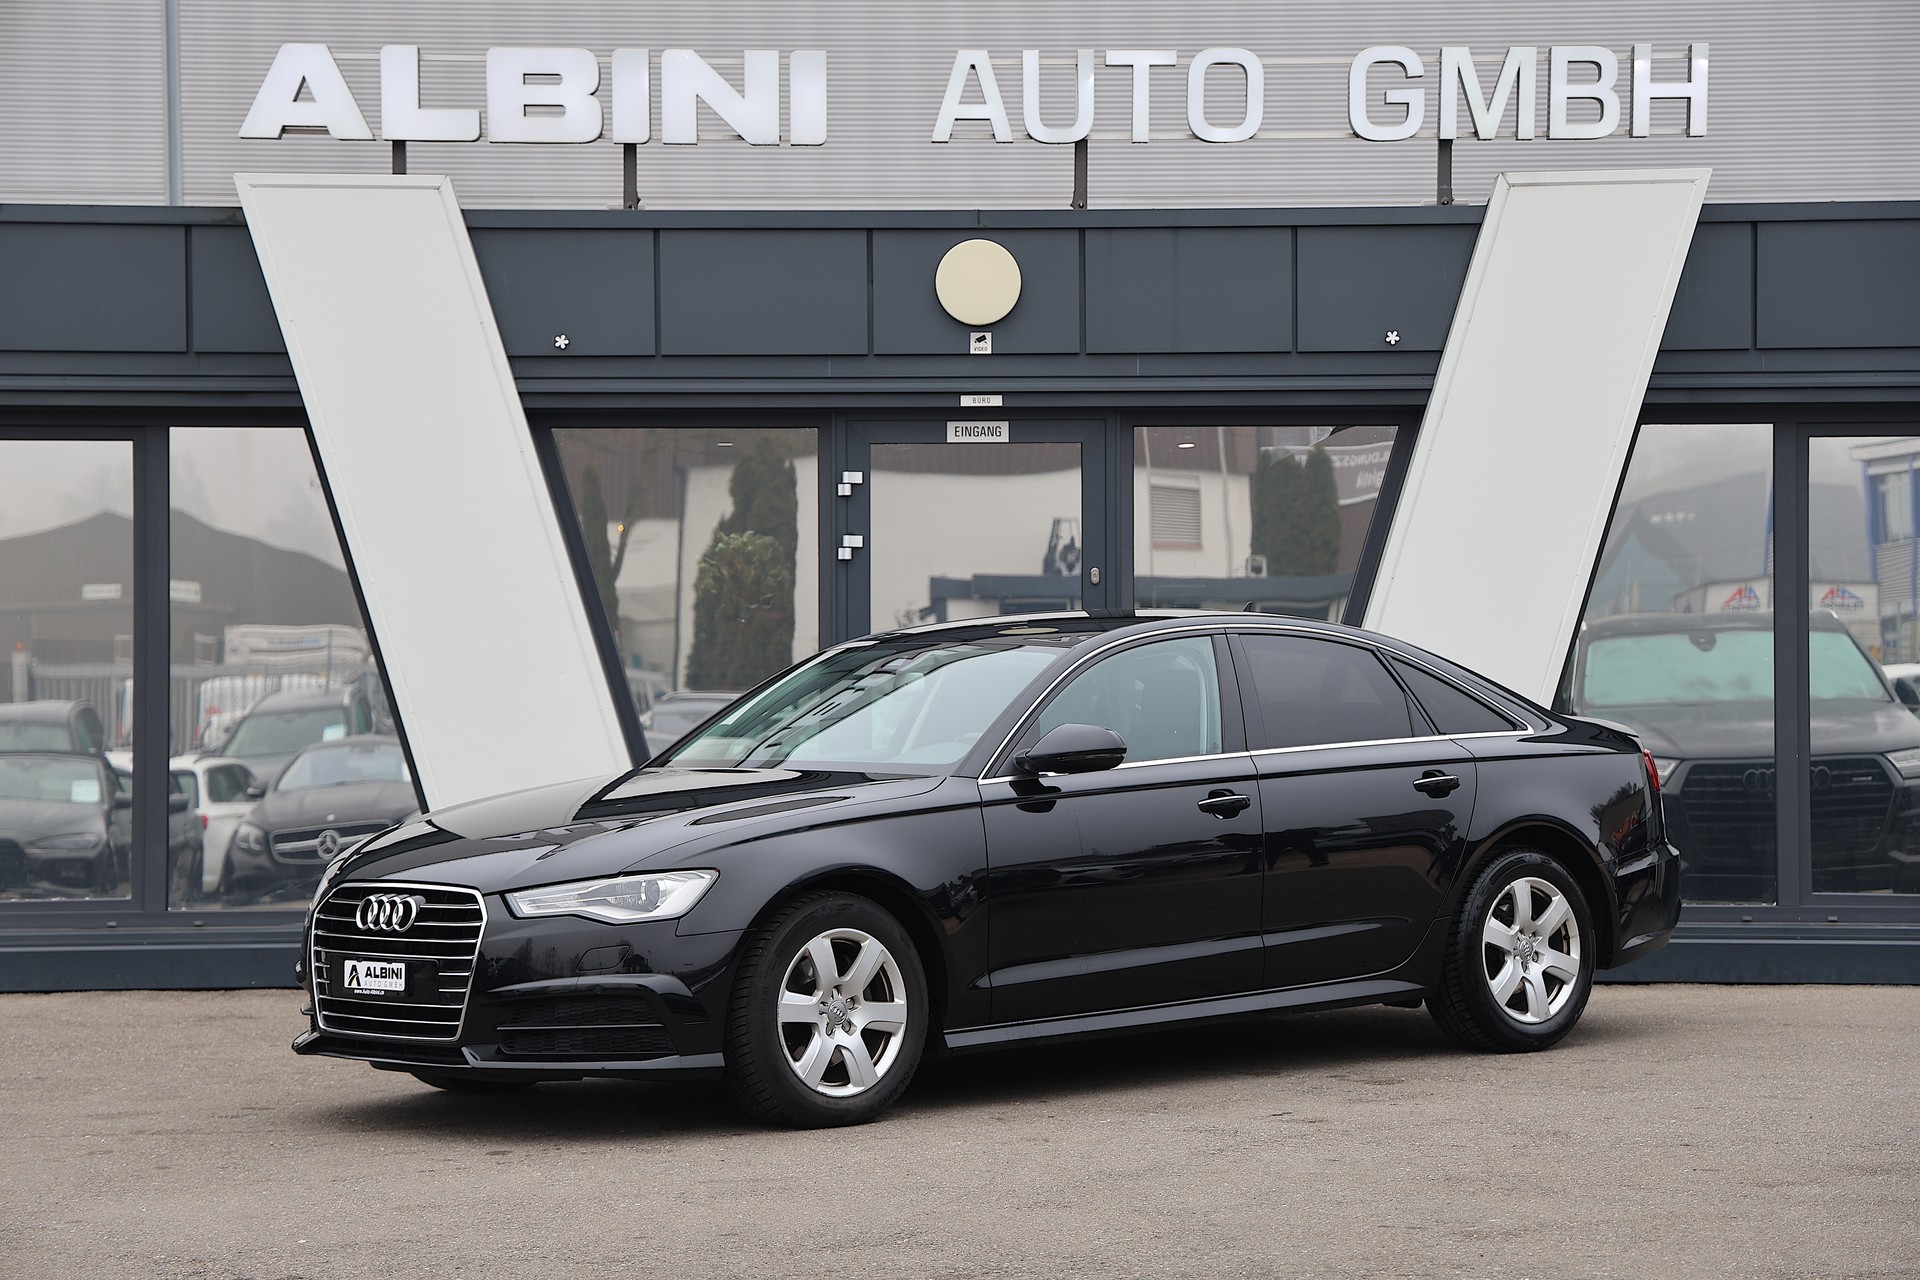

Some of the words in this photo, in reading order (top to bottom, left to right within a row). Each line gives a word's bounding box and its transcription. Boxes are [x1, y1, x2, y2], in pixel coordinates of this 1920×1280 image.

[239, 43, 827, 147] ALBINI
[931, 47, 1265, 144] AUTO
[1348, 42, 1710, 142] GMBH
[972, 396, 991, 404] BÜRO
[954, 425, 1002, 437] EINGANG
[365, 966, 402, 980] ALBINI
[364, 980, 381, 988] AUTO
[384, 981, 403, 989] GMBH
